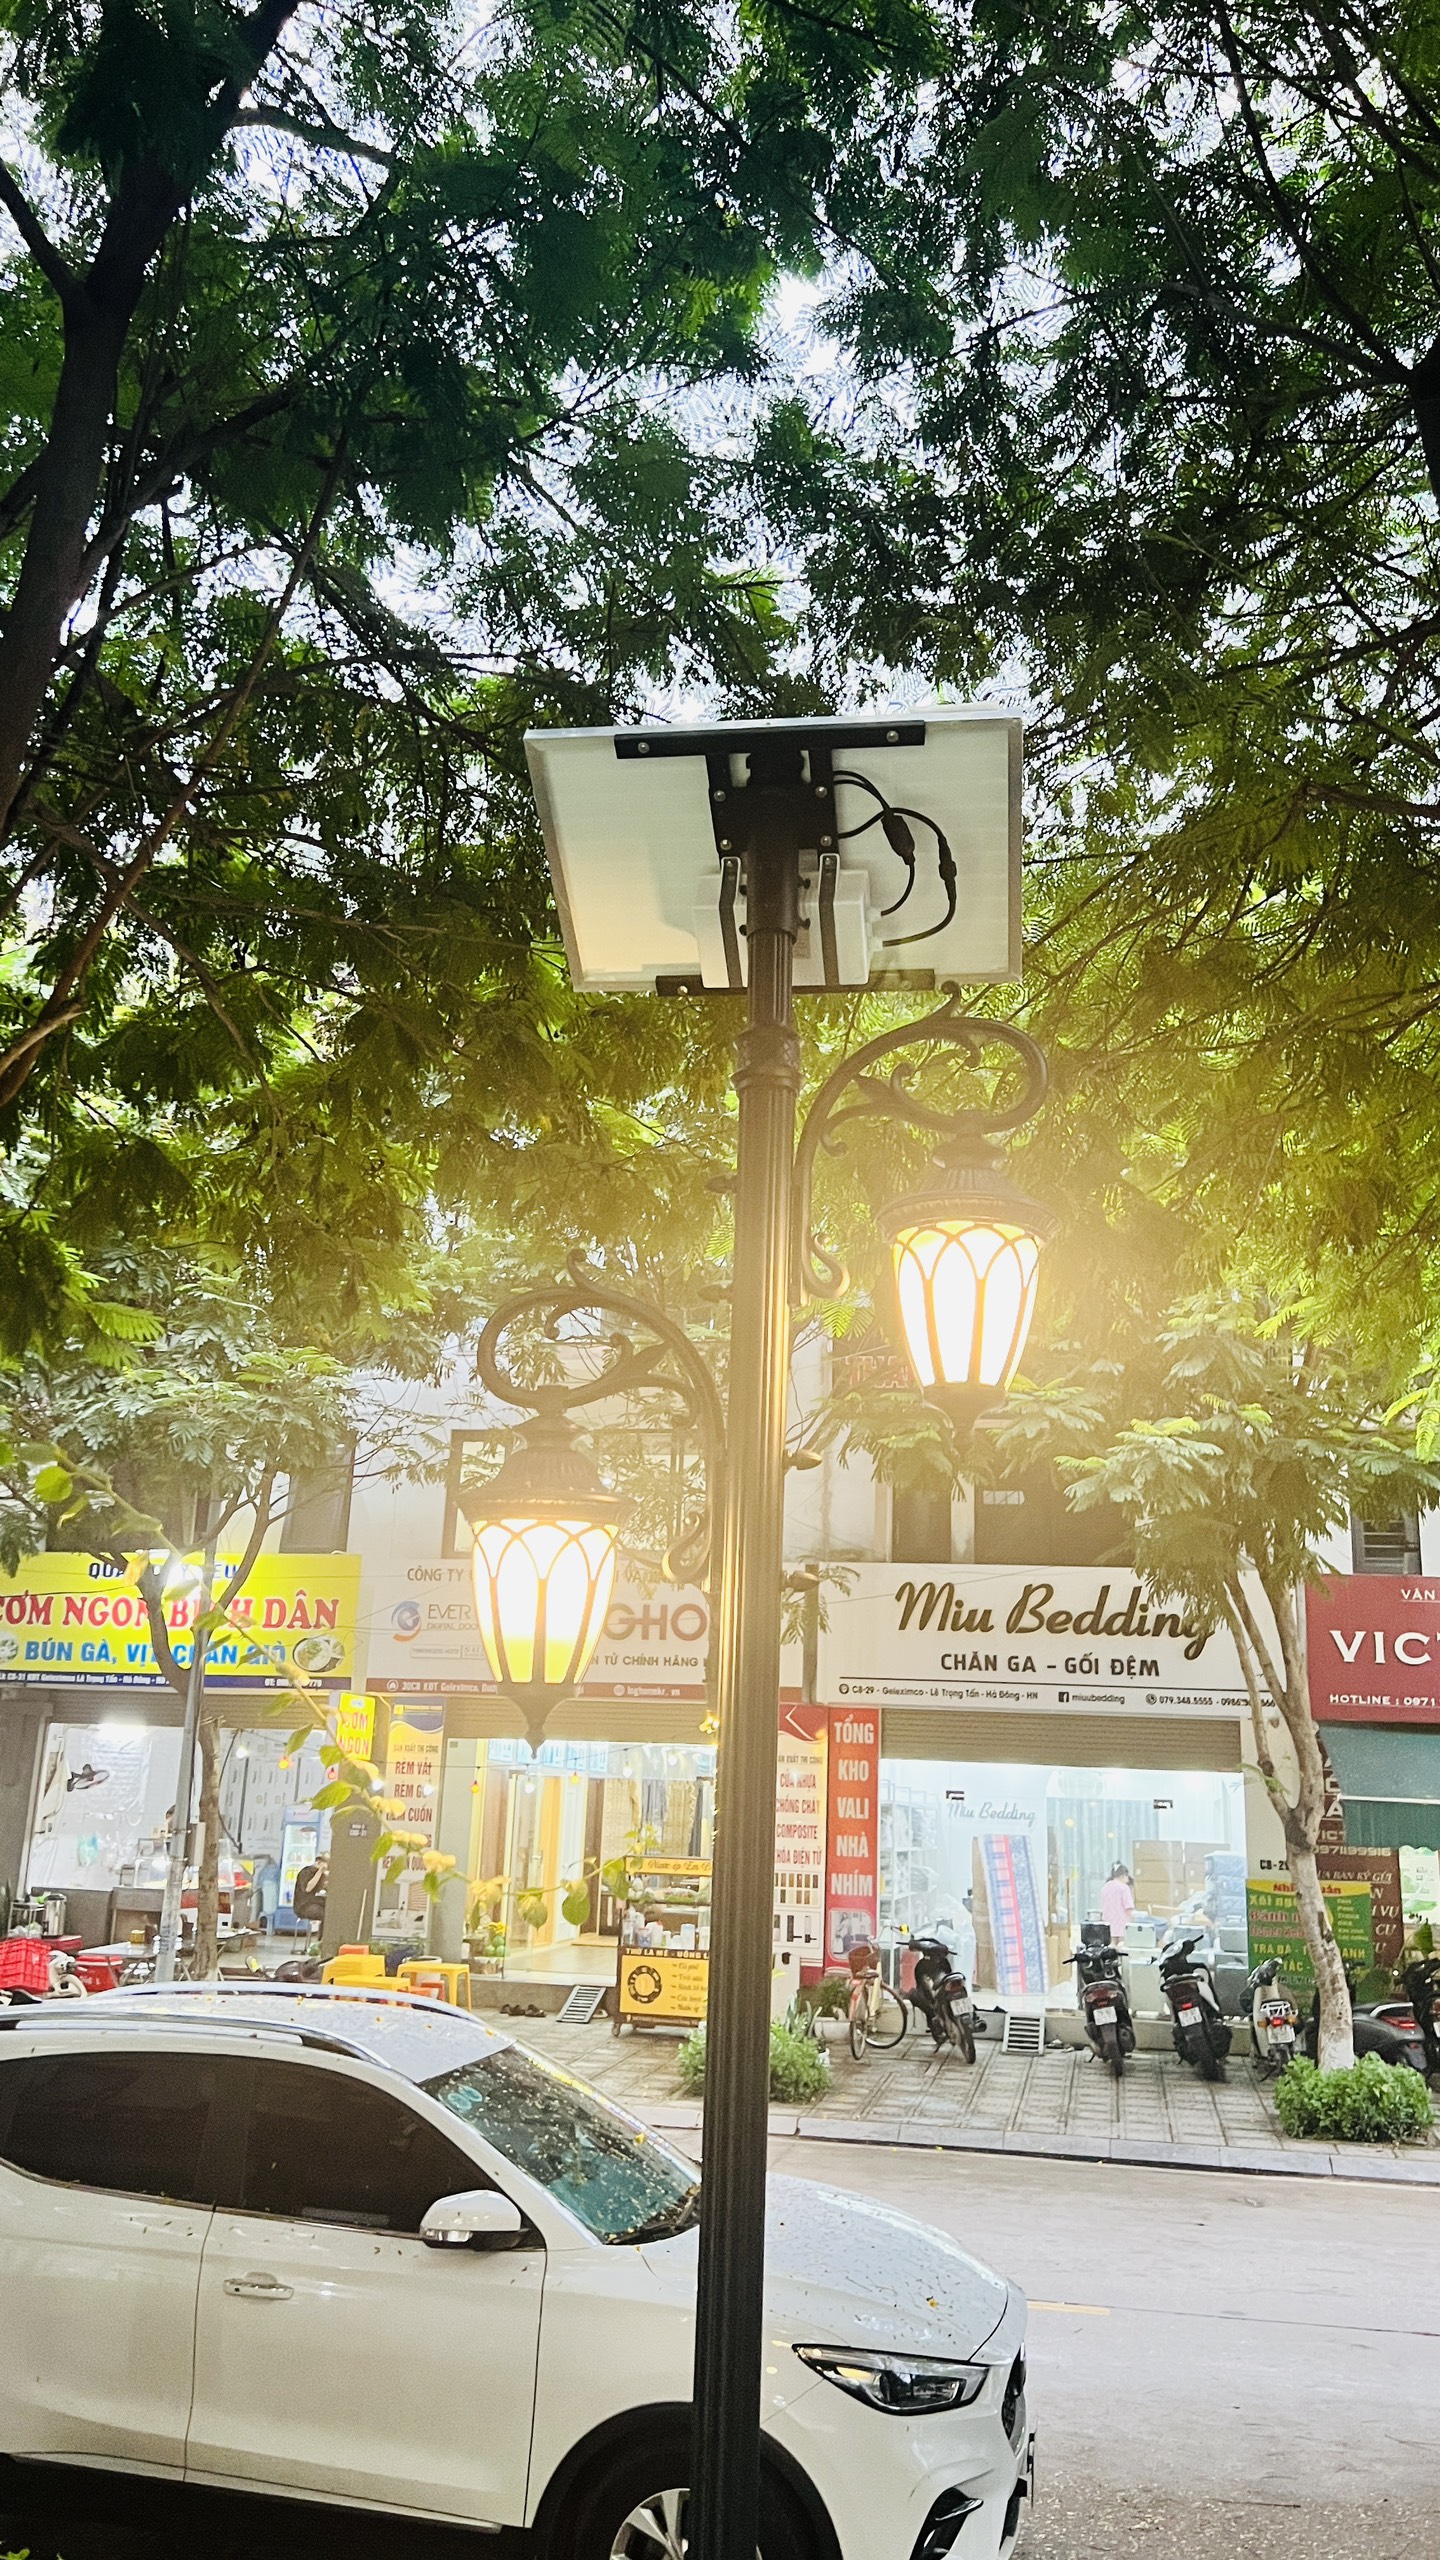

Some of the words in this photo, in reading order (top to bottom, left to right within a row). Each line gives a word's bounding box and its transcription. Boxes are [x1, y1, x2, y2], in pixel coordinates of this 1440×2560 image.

[407, 1565, 441, 1581] CÔNG
[447, 1569, 464, 1581] TY
[0, 1590, 53, 1626] ƠM
[262, 1590, 339, 1630] DÂN
[895, 1582, 993, 1633] Miu
[1006, 1583, 1214, 1660] Bedding
[25, 1638, 73, 1661] BÚN
[81, 1639, 117, 1664] GÀ,
[623, 1653, 659, 1666] CHÍNH
[1329, 1629, 1440, 1666] VIC
[941, 1652, 1000, 1673] CHĂN
[1007, 1655, 1036, 1674] GA
[1064, 1653, 1099, 1677] GỐI
[1111, 1659, 1160, 1678] ĐỆM
[1027, 1693, 1038, 1701] HN
[1329, 1694, 1390, 1706] HOTLINE
[1403, 1697, 1435, 1707] 0971
[834, 1713, 874, 1745] TỔNG
[838, 1759, 869, 1782] KHO
[836, 1796, 870, 1819] VALI
[949, 1802, 974, 1819] Miu
[978, 1801, 1036, 1827] Bedding
[776, 1823, 818, 1839] COMPOSITE
[836, 1831, 868, 1858] NHÀ
[830, 1870, 873, 1897] NHÍM
